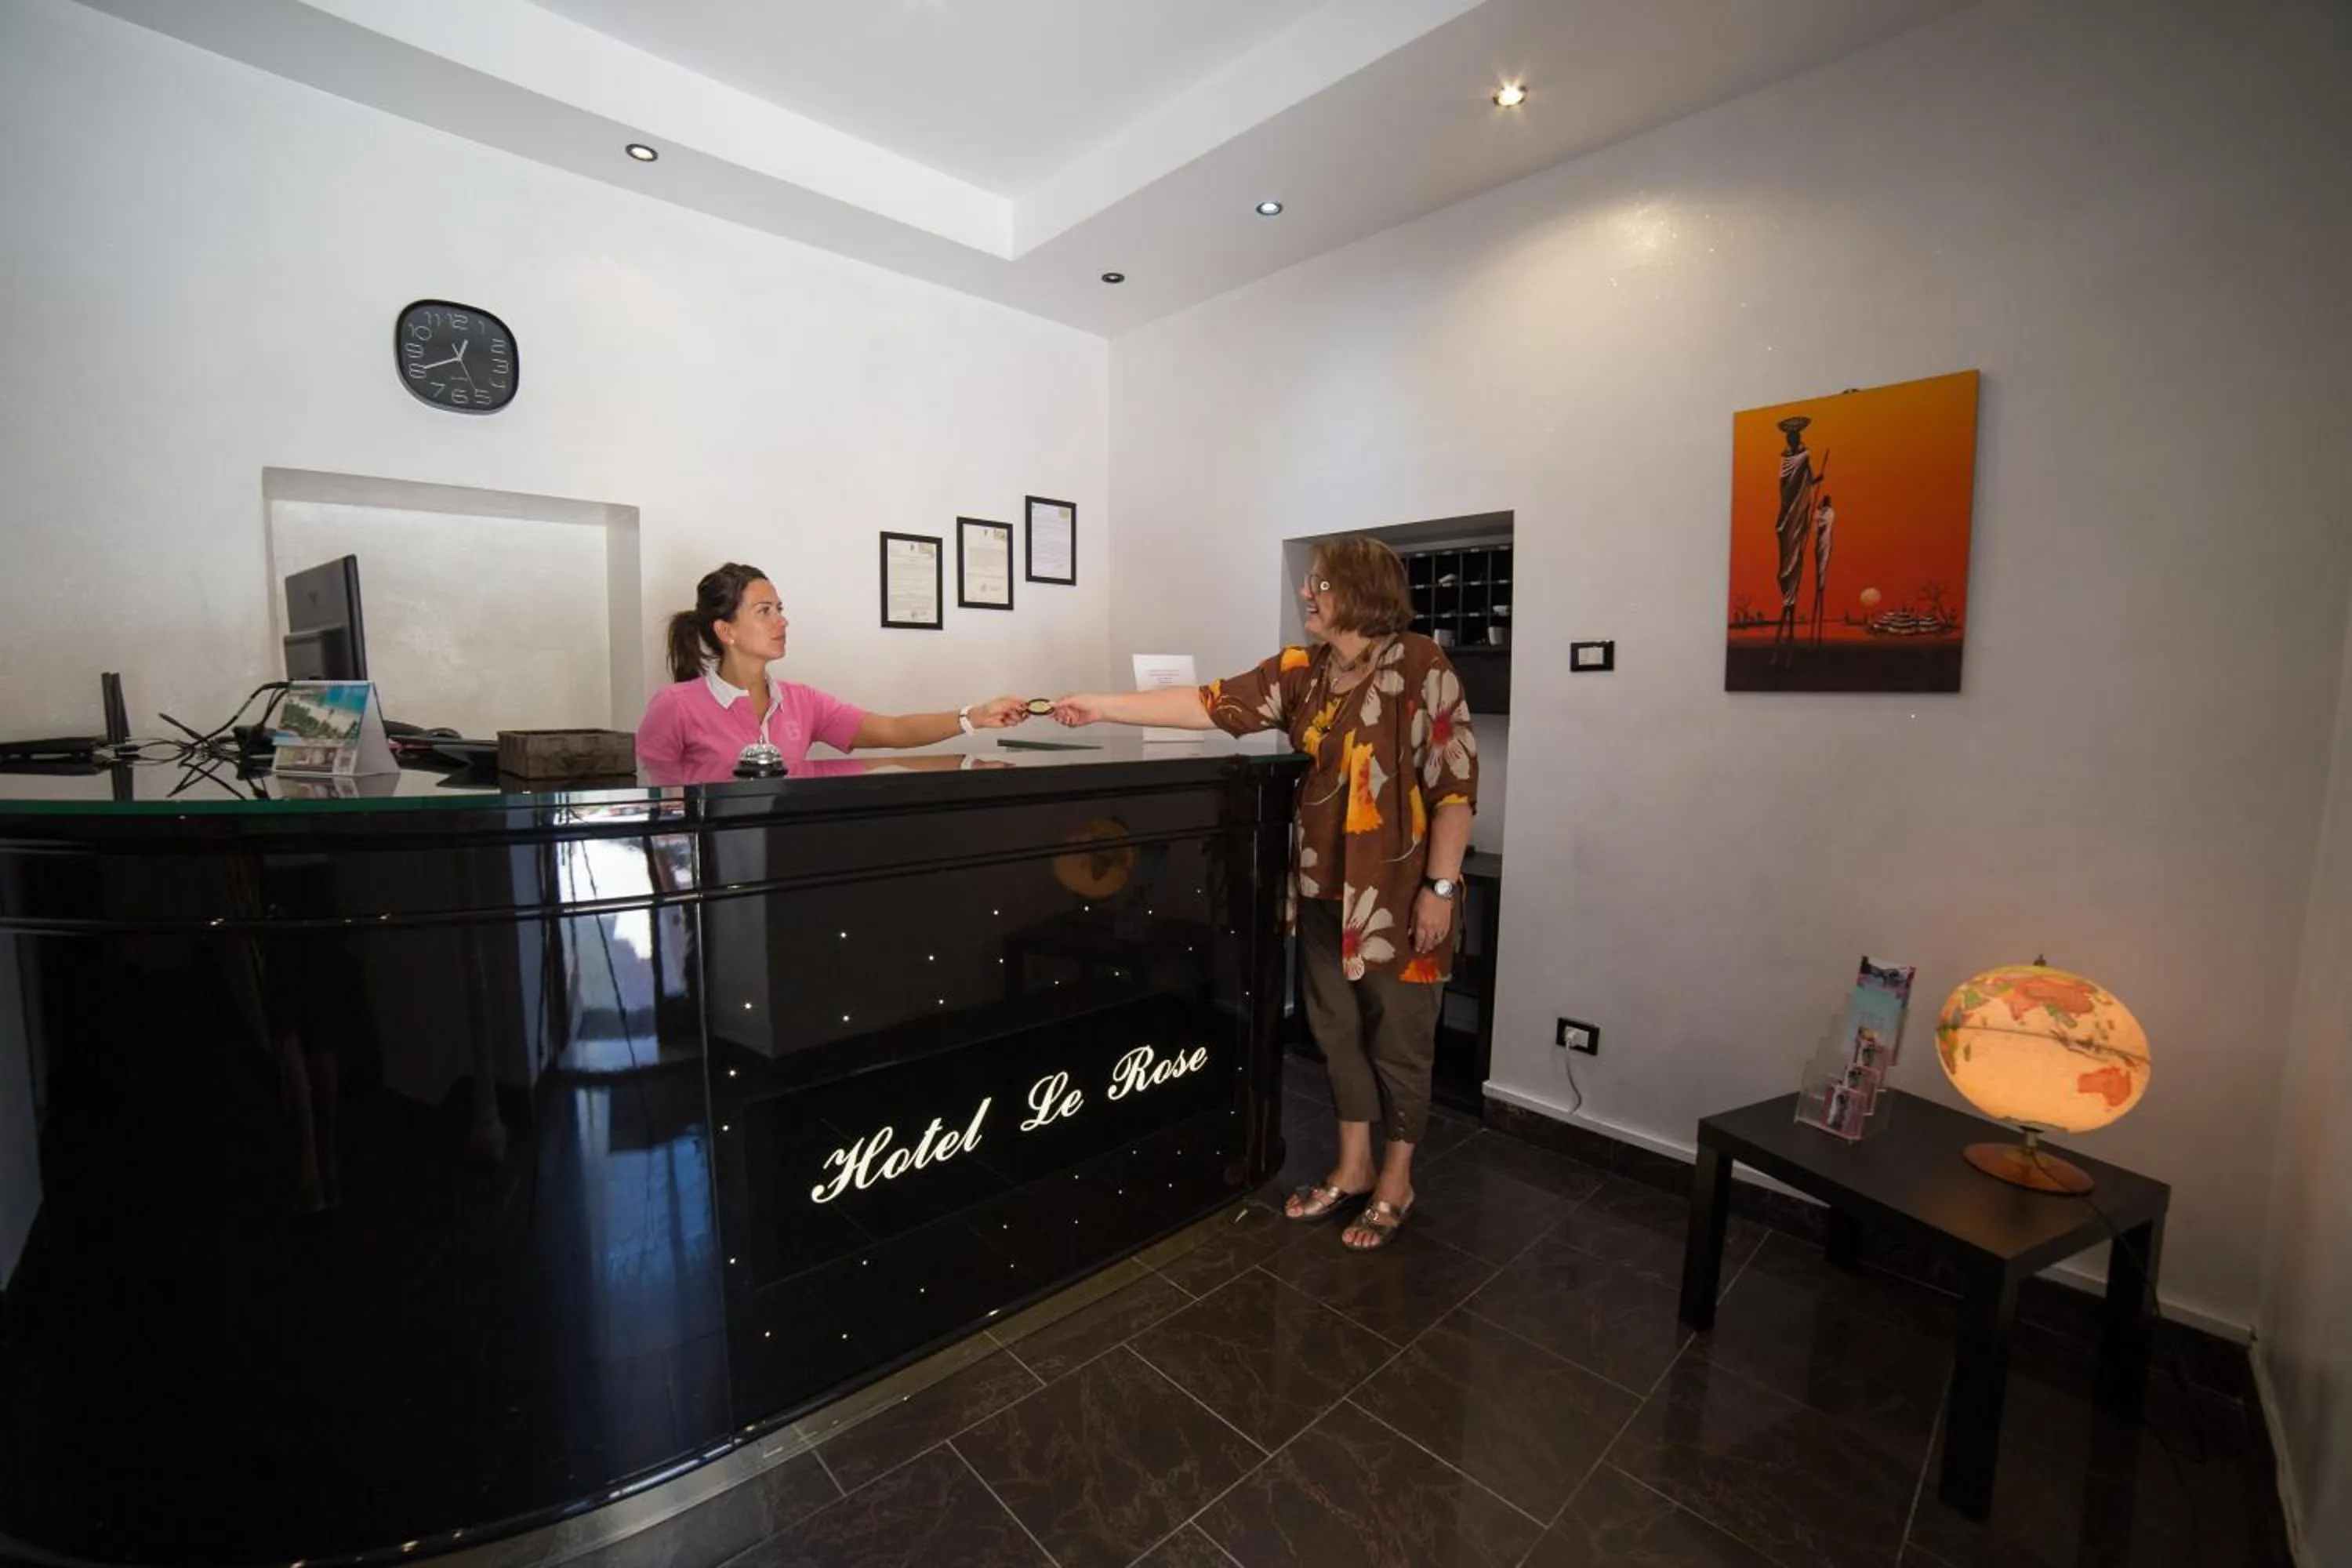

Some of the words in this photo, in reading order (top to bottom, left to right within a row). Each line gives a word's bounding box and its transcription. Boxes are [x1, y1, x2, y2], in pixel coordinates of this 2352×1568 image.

[448, 312, 469, 331] 12
[477, 319, 485, 335] 1
[408, 322, 433, 341] 10
[405, 343, 424, 358] 9
[490, 338, 506, 355] 2
[408, 363, 427, 379] 8
[492, 358, 510, 374] 3
[430, 382, 446, 397] 7
[452, 388, 469, 404] 6
[474, 389, 492, 405] 5
[811, 1097, 992, 1203] Hotel
[1020, 1071, 1084, 1131] Le
[1107, 1044, 1209, 1101] Rose
